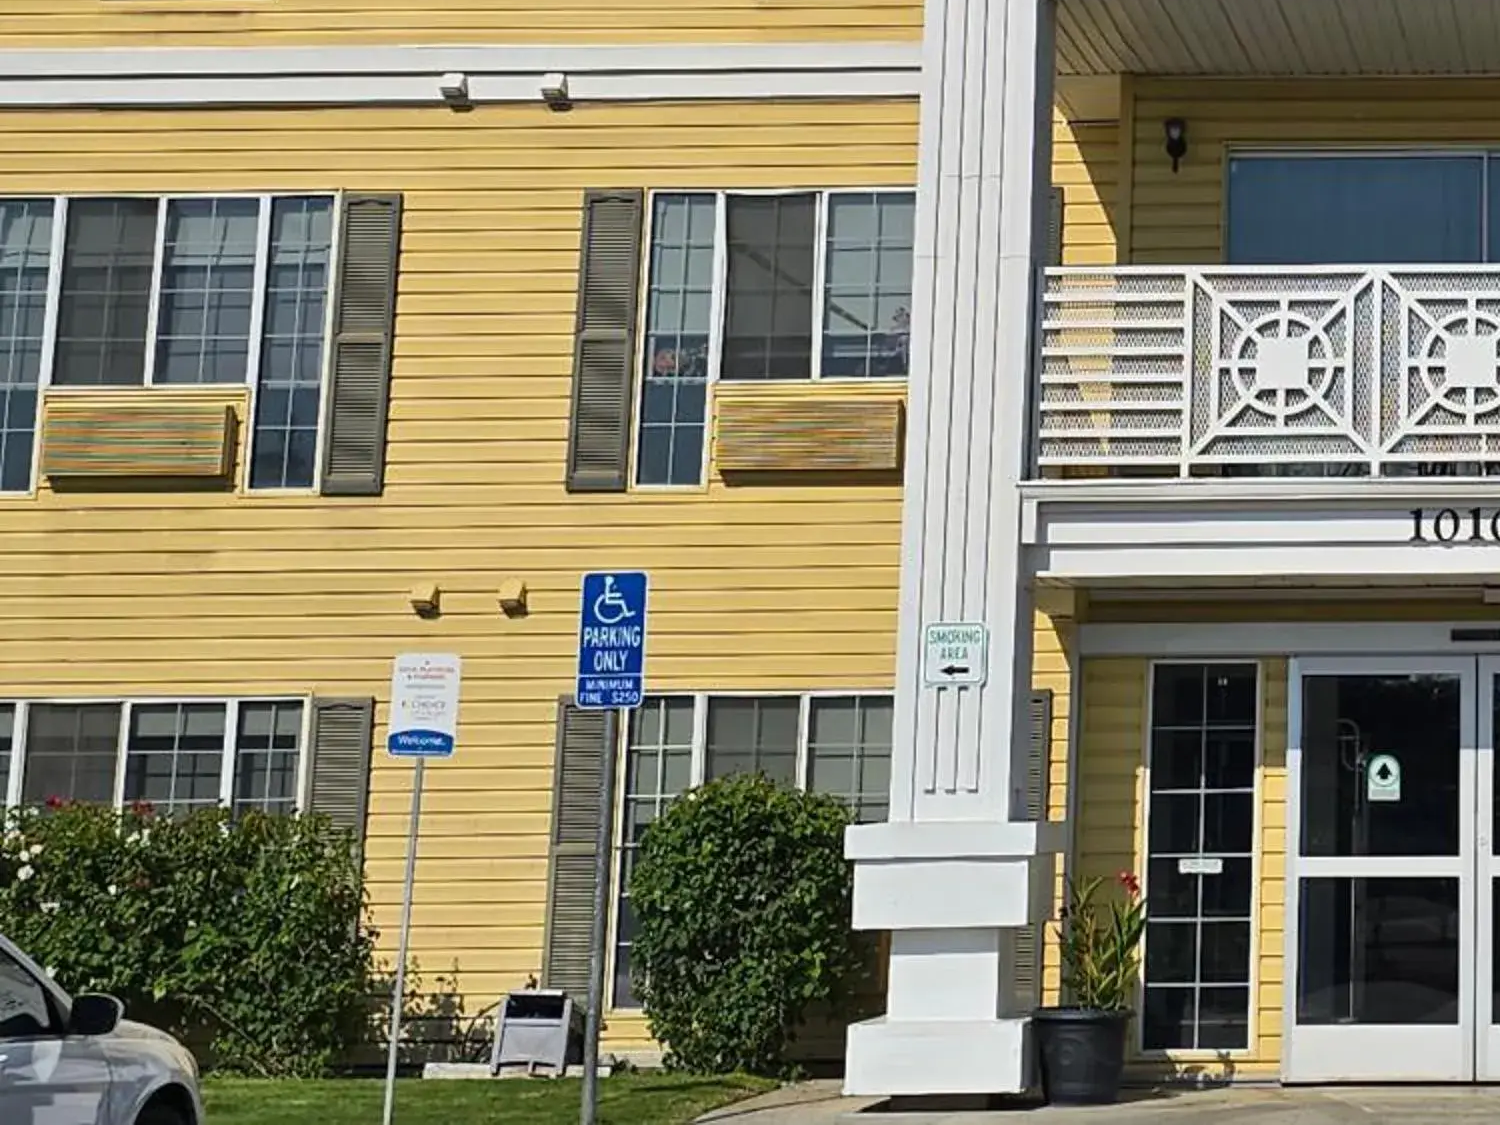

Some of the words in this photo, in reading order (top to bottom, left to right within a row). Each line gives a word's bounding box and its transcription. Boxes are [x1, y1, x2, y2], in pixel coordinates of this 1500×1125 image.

[583, 626, 641, 648] PARKING
[928, 629, 981, 644] SMOKING
[940, 646, 968, 660] AREA
[593, 650, 629, 672] ONLY
[585, 679, 634, 690] MINIMUM
[579, 692, 603, 704] FINE
[611, 690, 640, 704] $250
